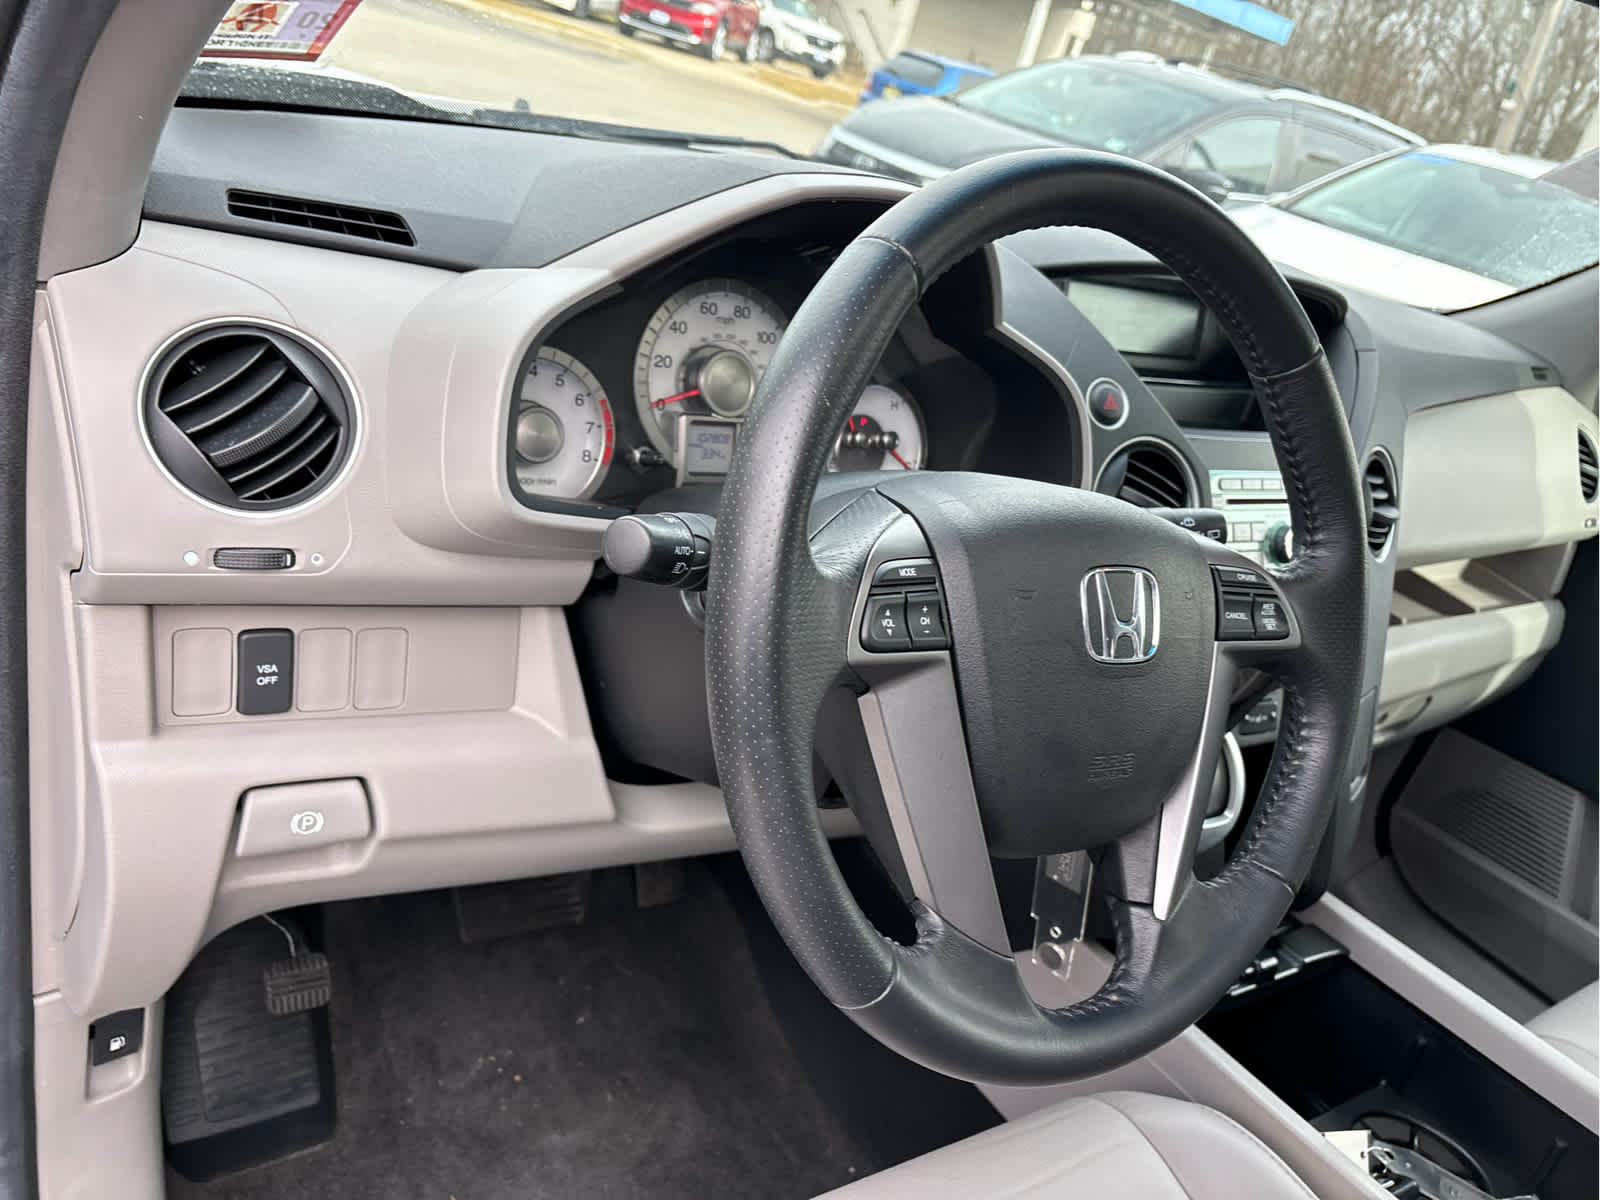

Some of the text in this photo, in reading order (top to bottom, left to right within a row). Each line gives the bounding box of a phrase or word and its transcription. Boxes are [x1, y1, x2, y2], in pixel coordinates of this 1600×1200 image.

[700, 302, 718, 316] 60
[733, 304, 750, 319] 80
[669, 321, 687, 335] 40
[757, 331, 776, 345] 100
[654, 355, 673, 369] 20
[554, 373, 565, 387] 5
[575, 393, 585, 406] 6
[585, 421, 595, 434] 7
[583, 450, 592, 463] 8
[674, 546, 691, 555] AUTO
[899, 567, 917, 577] MODE
[881, 619, 896, 628] VOL
[919, 616, 931, 626] CH
[256, 664, 279, 674] VSA
[256, 675, 279, 686] OFF
